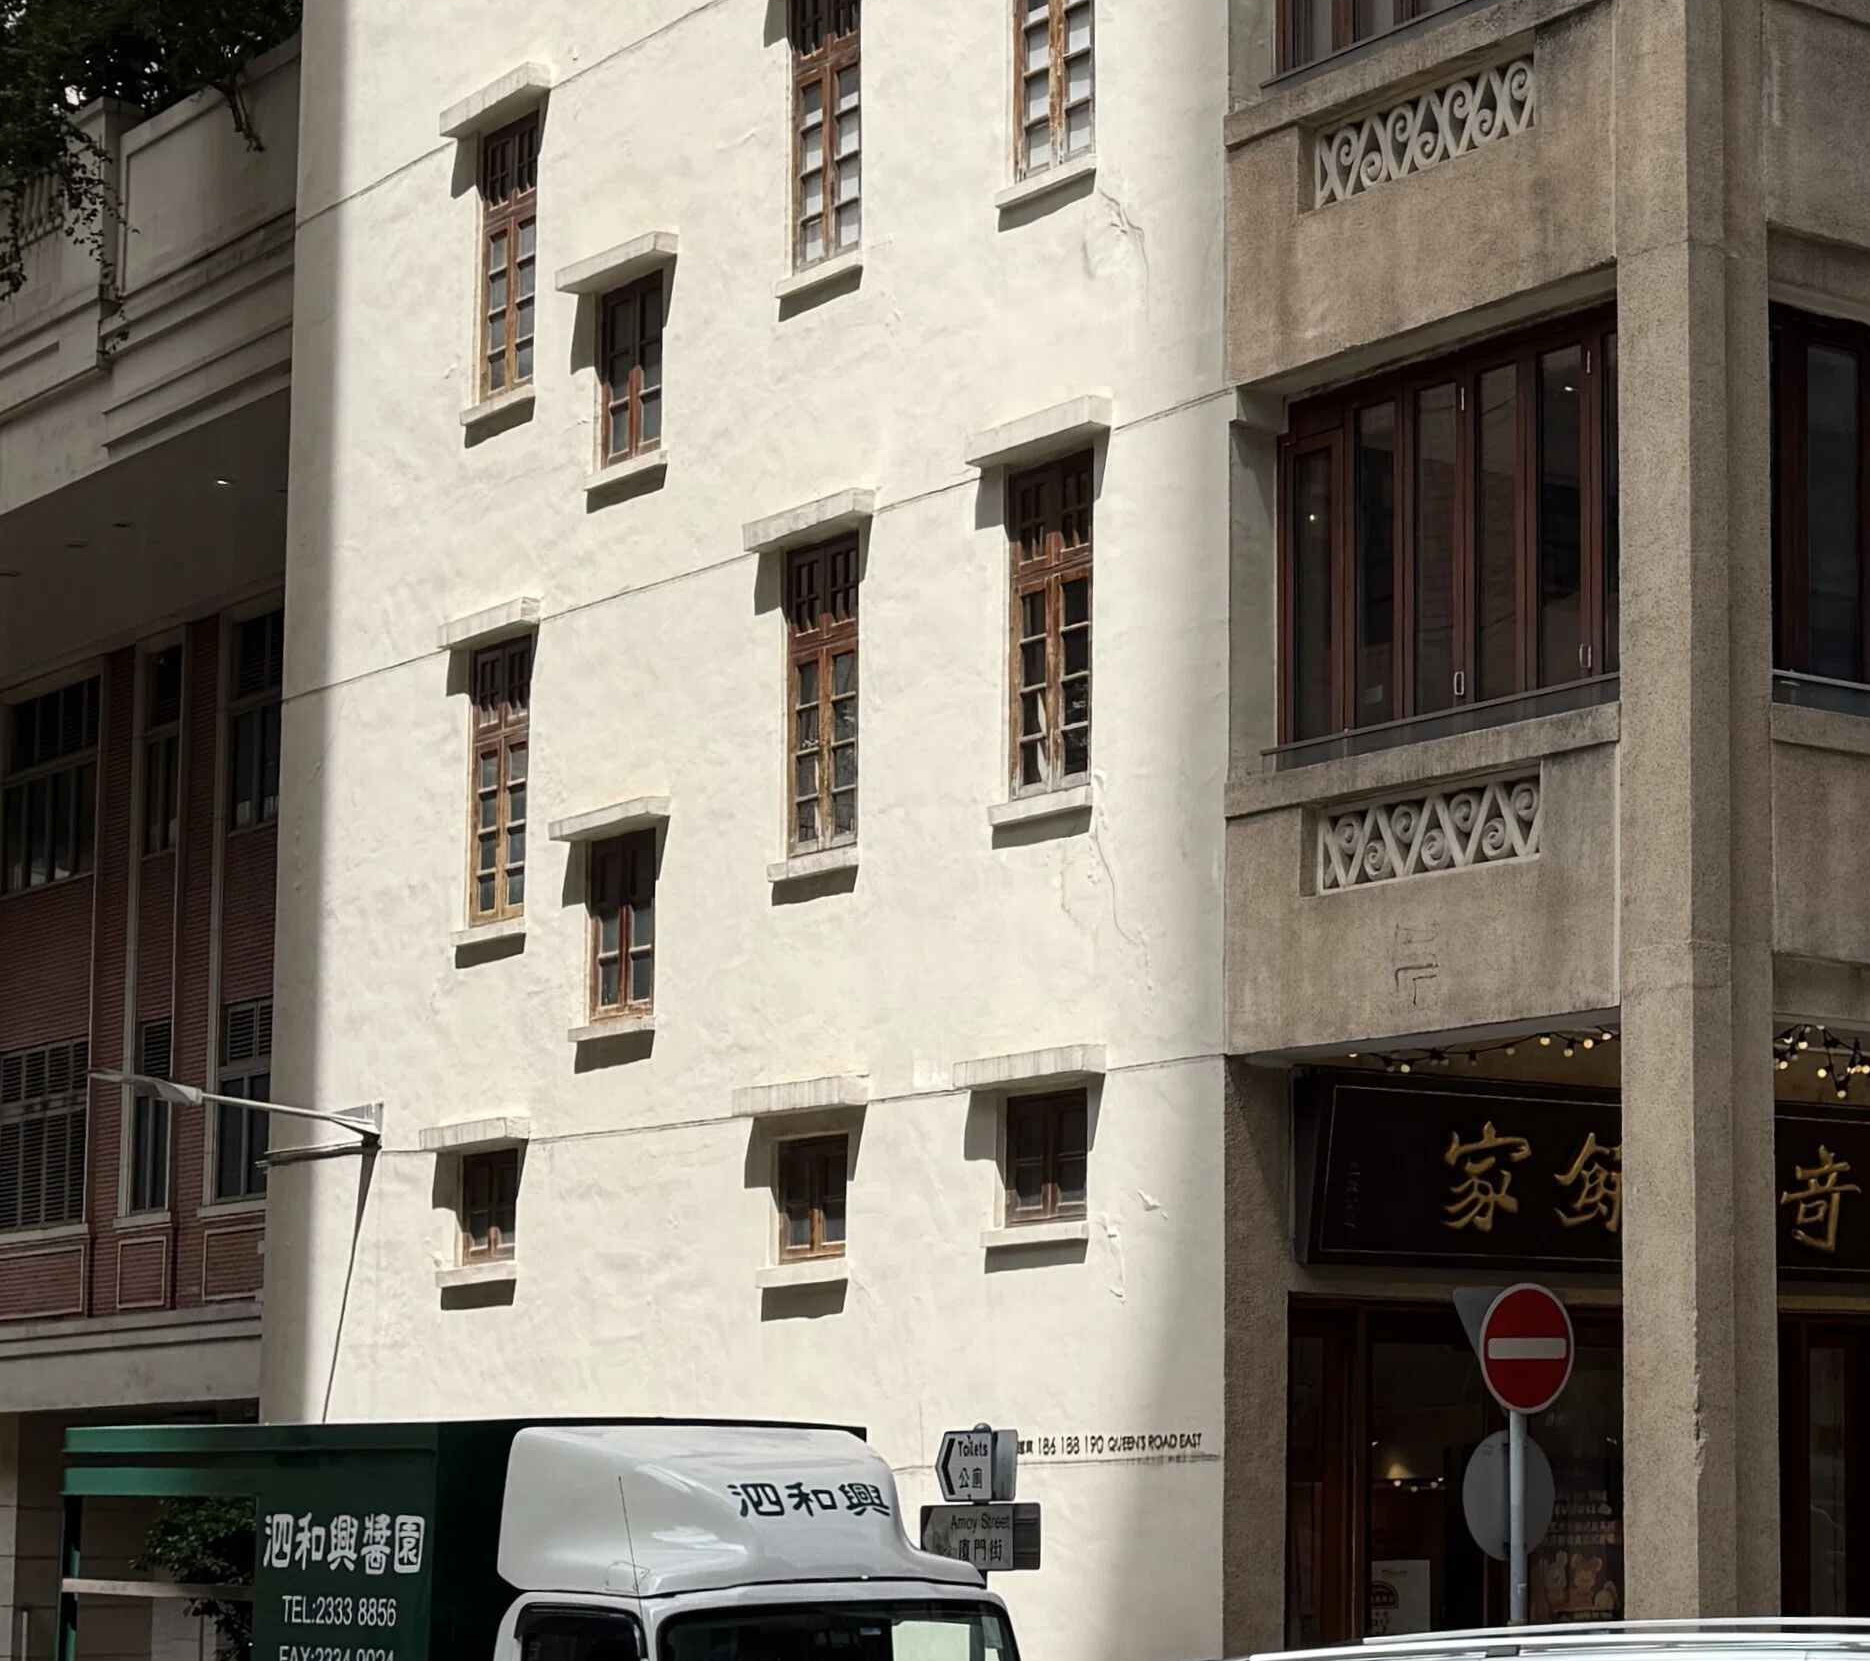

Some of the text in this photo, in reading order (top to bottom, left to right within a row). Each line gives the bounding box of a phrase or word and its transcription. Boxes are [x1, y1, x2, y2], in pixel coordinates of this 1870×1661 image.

[958, 1440, 988, 1457] Toilets
[1038, 1436, 1056, 1456] 186
[1061, 1436, 1080, 1455] 188
[1085, 1435, 1104, 1454] 190
[1148, 1433, 1178, 1451] ROAD
[1180, 1433, 1202, 1449] EAST
[951, 1512, 1011, 1534] Amoy Street
[282, 1595, 397, 1628] TEL:2333 8856
